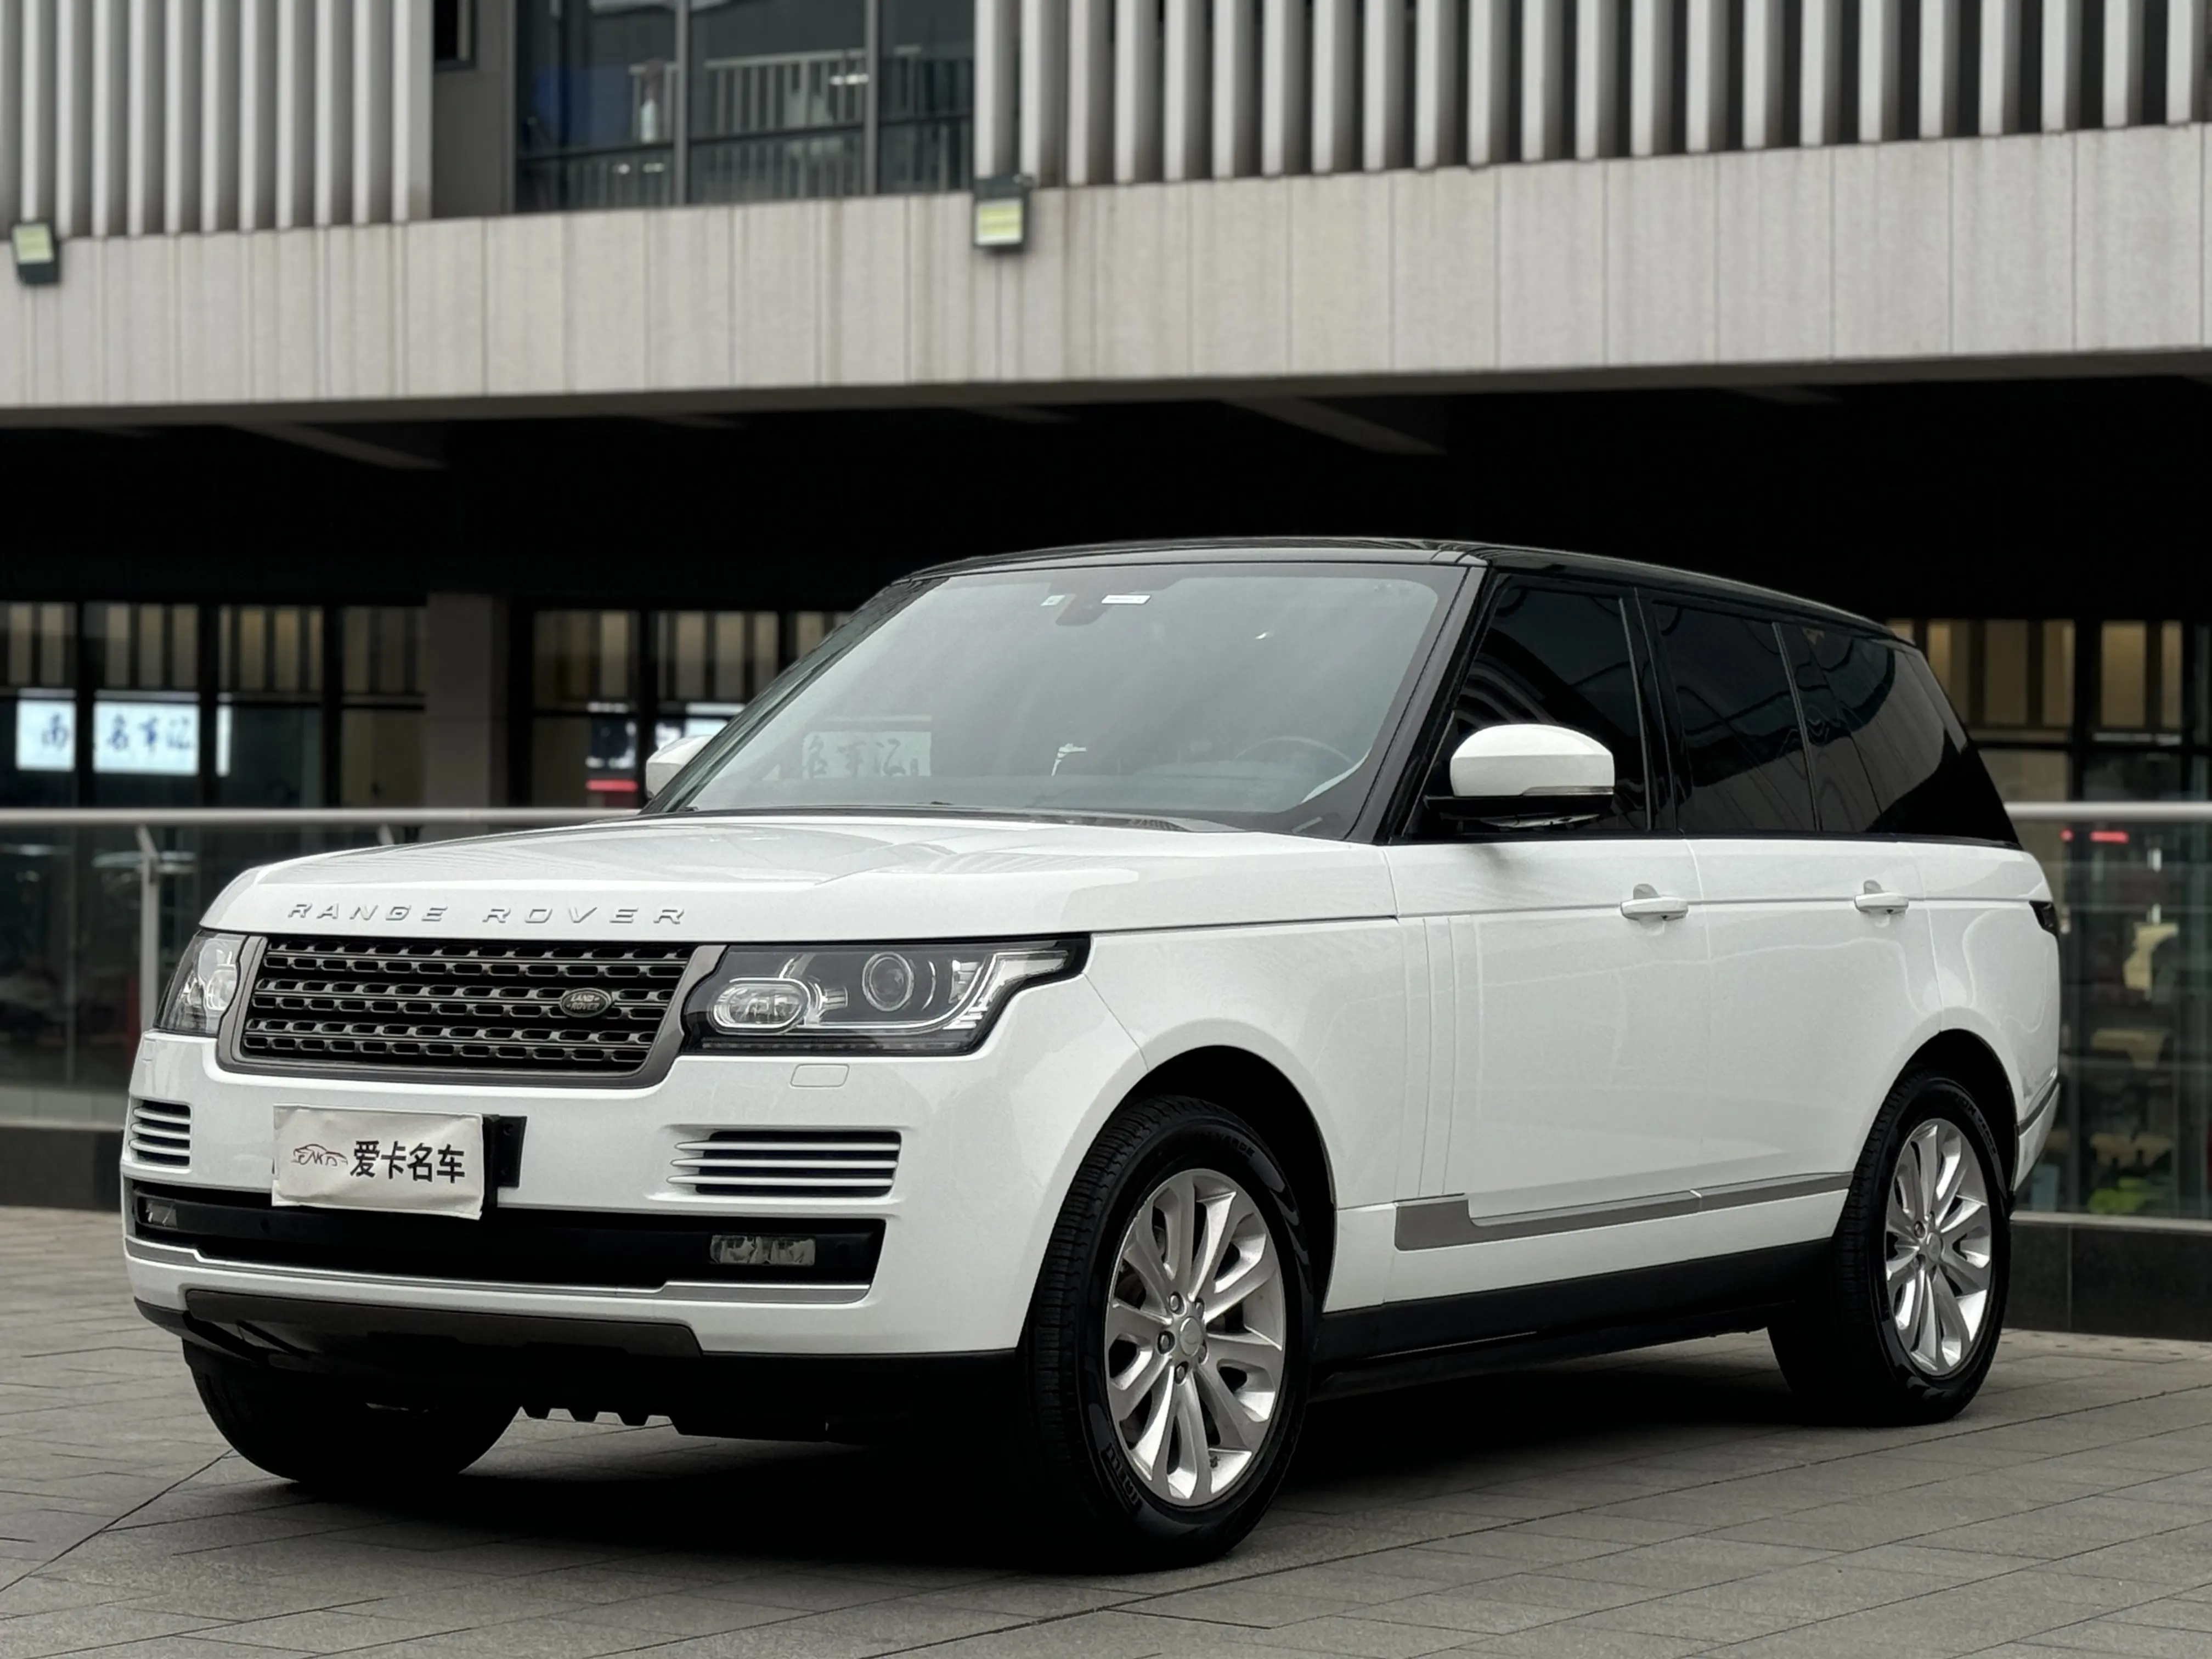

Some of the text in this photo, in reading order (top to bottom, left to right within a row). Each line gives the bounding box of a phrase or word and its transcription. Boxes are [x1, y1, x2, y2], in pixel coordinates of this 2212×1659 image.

[287, 903, 685, 925] RANGE ROVER
[571, 994, 595, 1002] LAND
[350, 1140, 465, 1184] 爱卡名车
